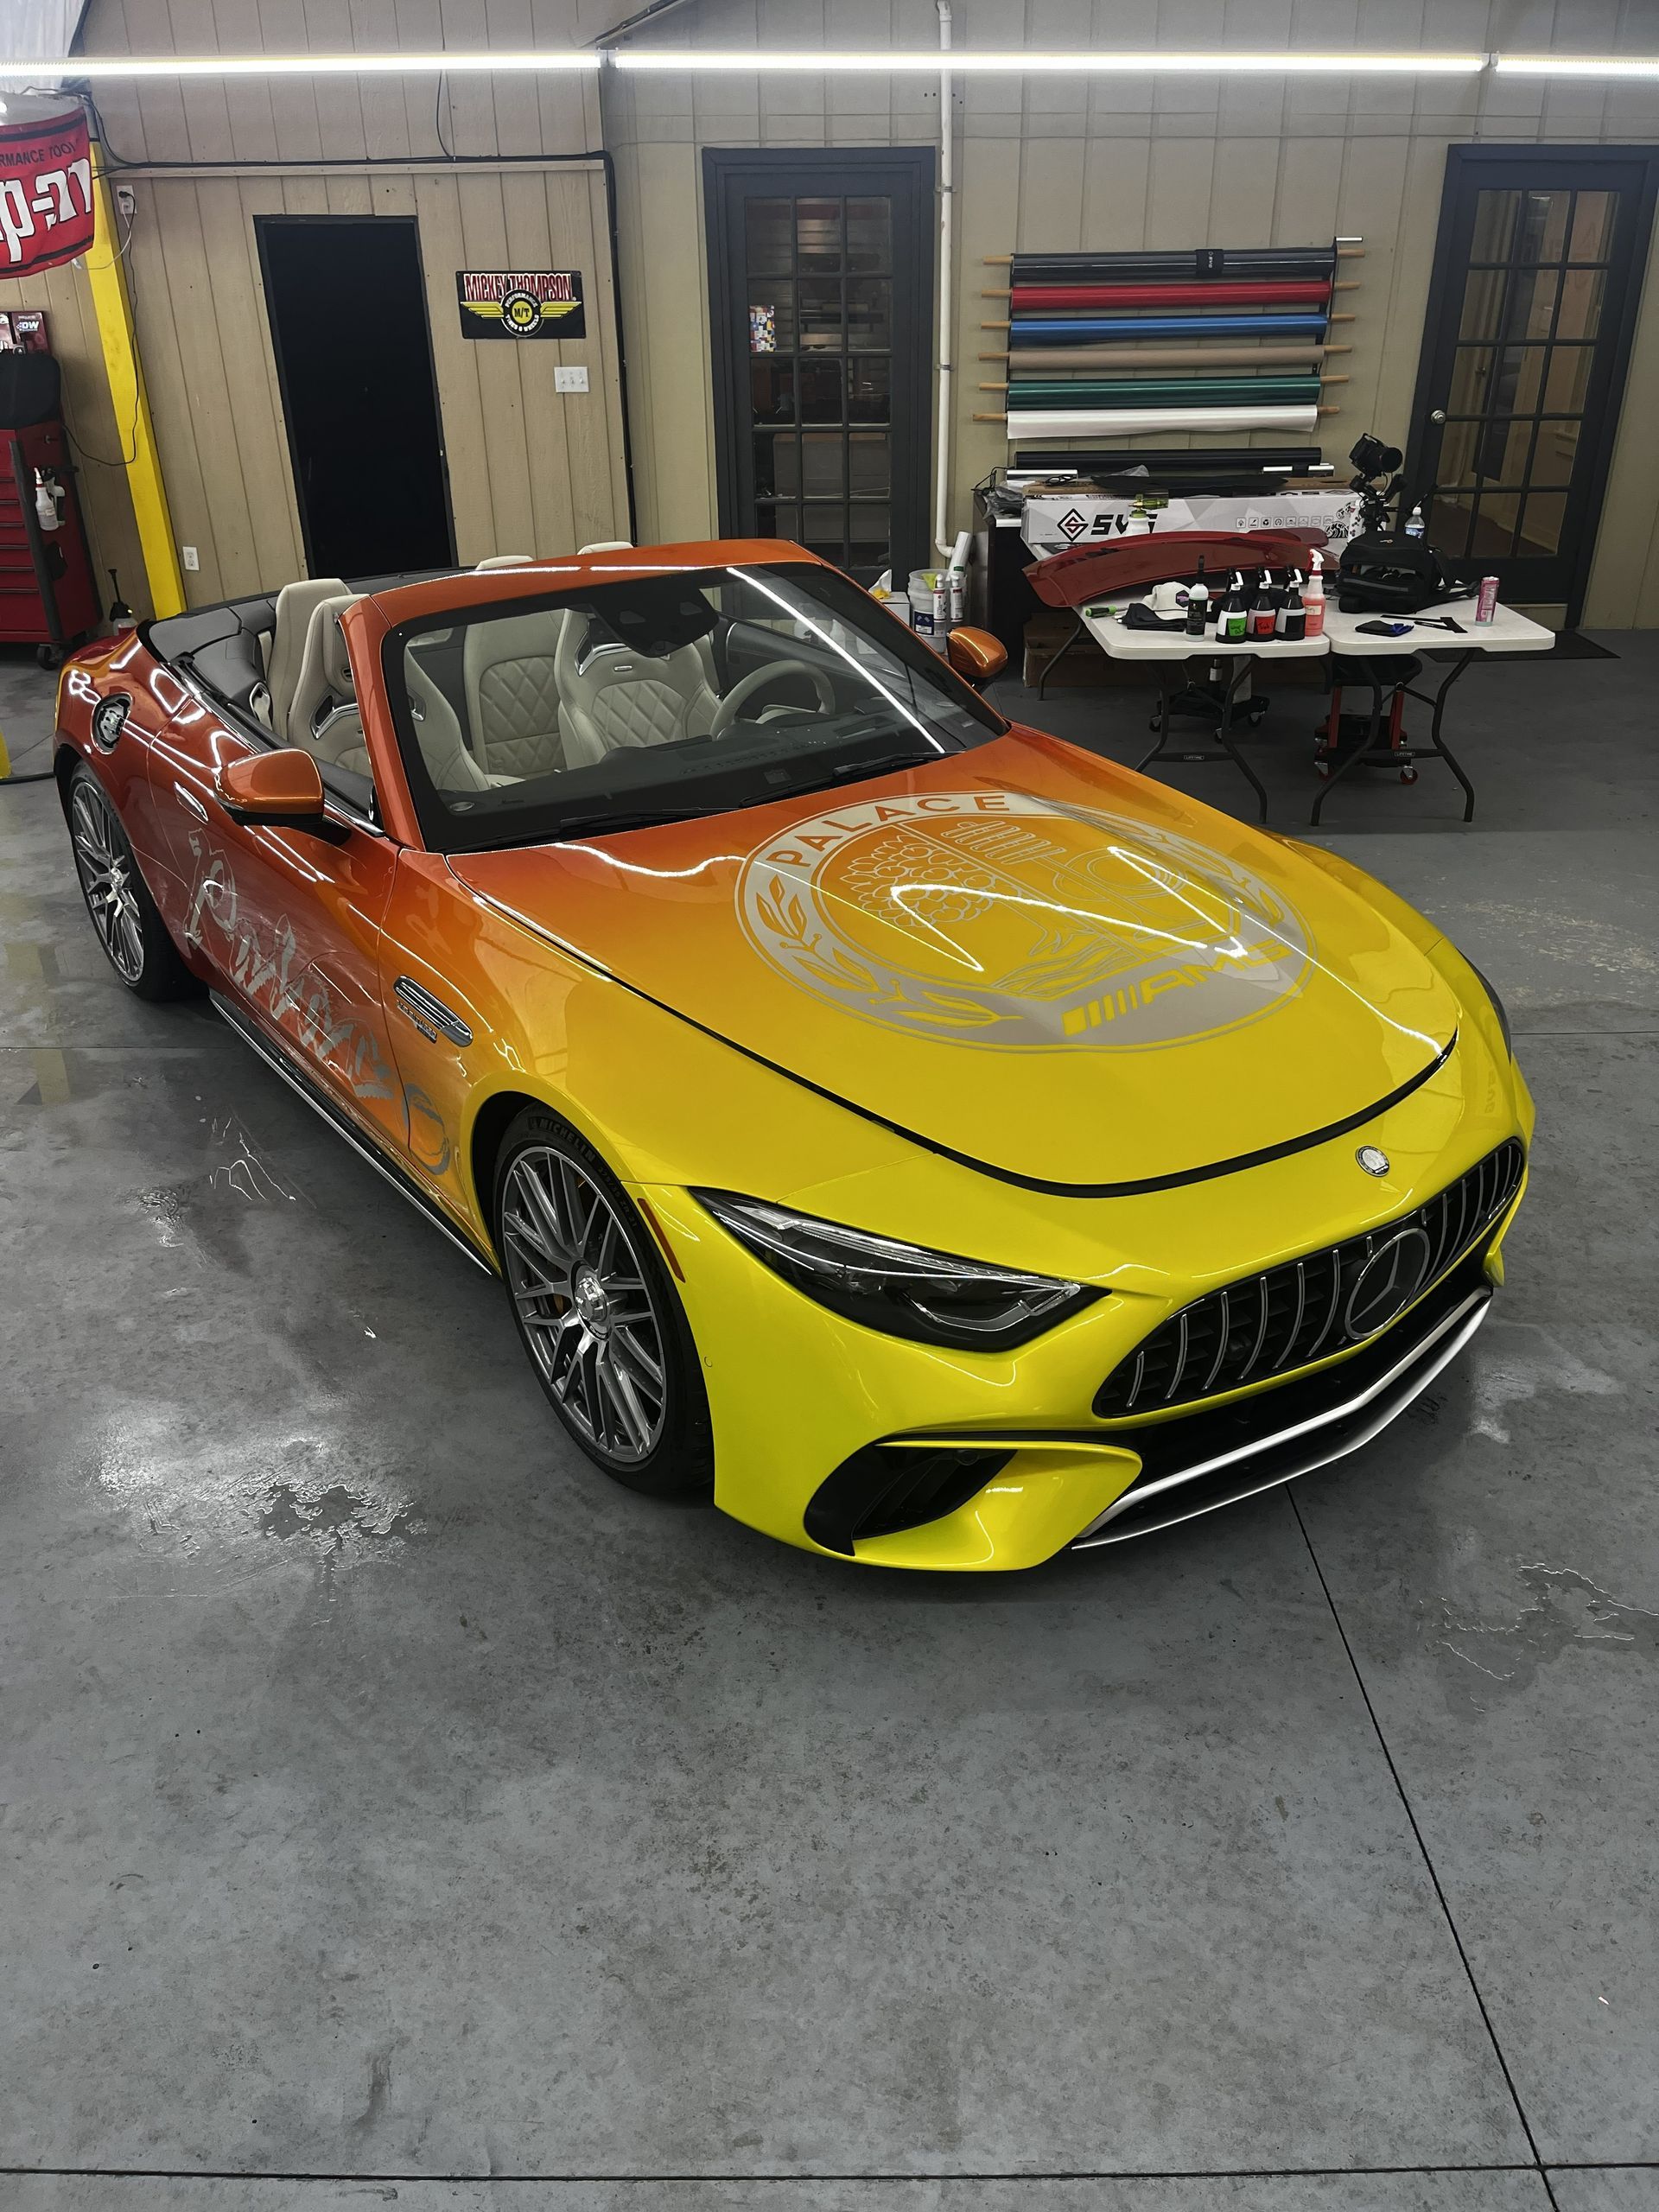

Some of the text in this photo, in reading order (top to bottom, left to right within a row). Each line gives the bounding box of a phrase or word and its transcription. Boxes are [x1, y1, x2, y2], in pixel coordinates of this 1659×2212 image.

[463, 273, 574, 301] MICKEY THOMPSON
[513, 306, 530, 319] M/T
[769, 795, 1010, 868] PALACE
[539, 1118, 596, 1161] MICHELIN
